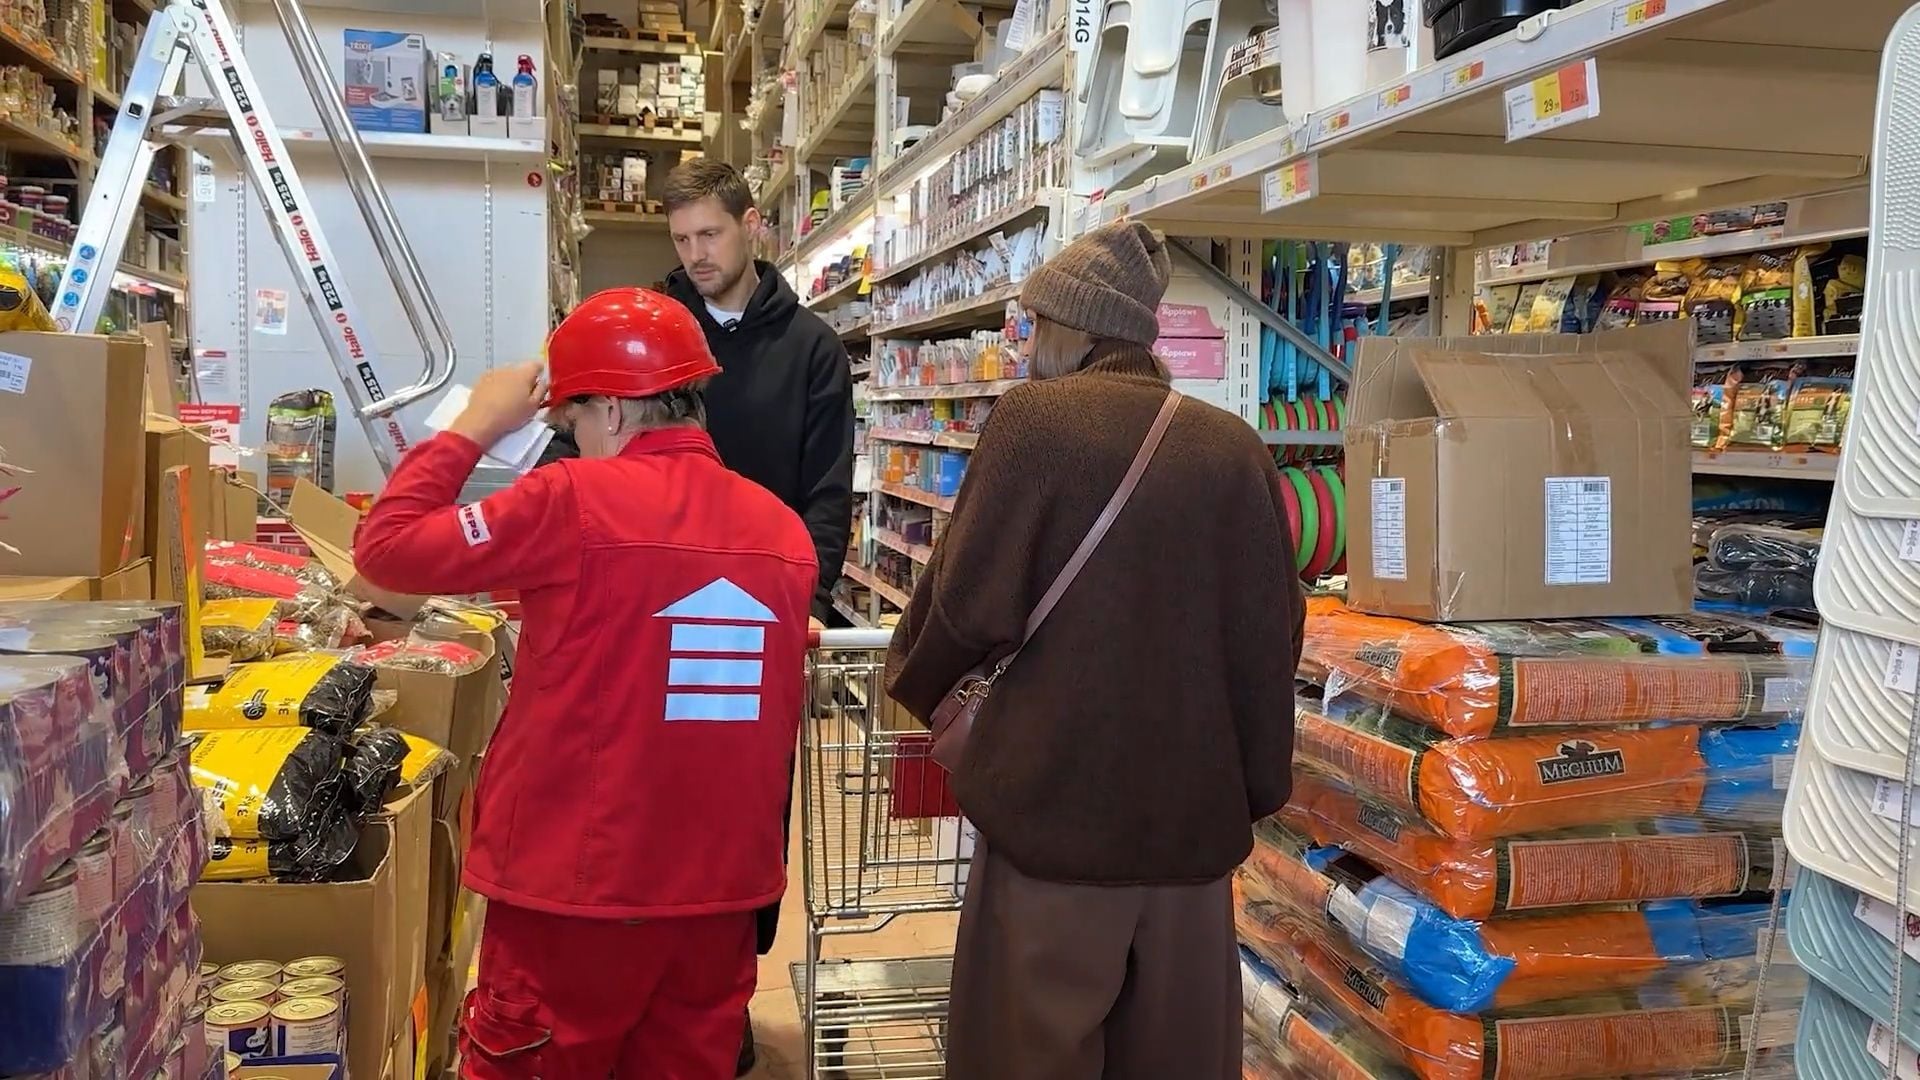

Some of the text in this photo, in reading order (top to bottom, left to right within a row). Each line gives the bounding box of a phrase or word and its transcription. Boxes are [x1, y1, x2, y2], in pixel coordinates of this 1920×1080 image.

[231, 83, 250, 108] 225
[255, 130, 275, 162] Hailo
[277, 185, 295, 207] 225
[299, 229, 320, 262] Hailo
[321, 283, 339, 306] 225
[344, 326, 364, 359] Hailo
[366, 380, 384, 402] 225
[388, 421, 409, 453] Hailo
[1542, 755, 1622, 781] MEGLIUM
